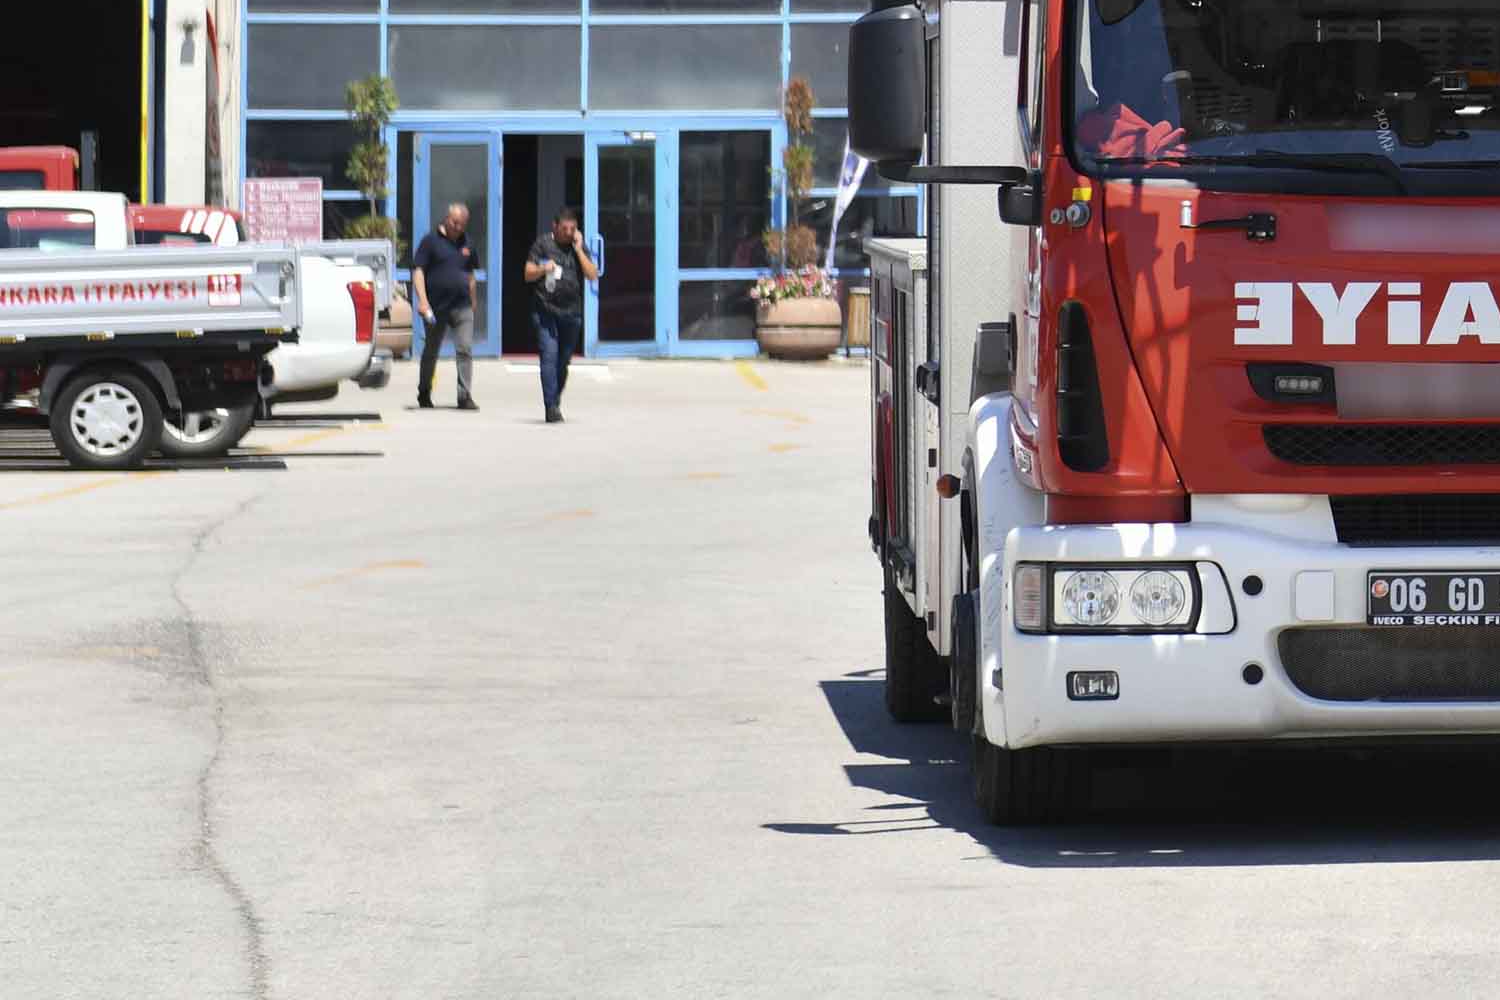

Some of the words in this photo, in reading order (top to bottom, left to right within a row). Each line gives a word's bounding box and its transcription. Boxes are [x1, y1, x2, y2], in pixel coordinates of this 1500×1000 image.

[1389, 577, 1427, 612] 06
[1448, 577, 1485, 612] GD
[1373, 616, 1405, 625] IVECO
